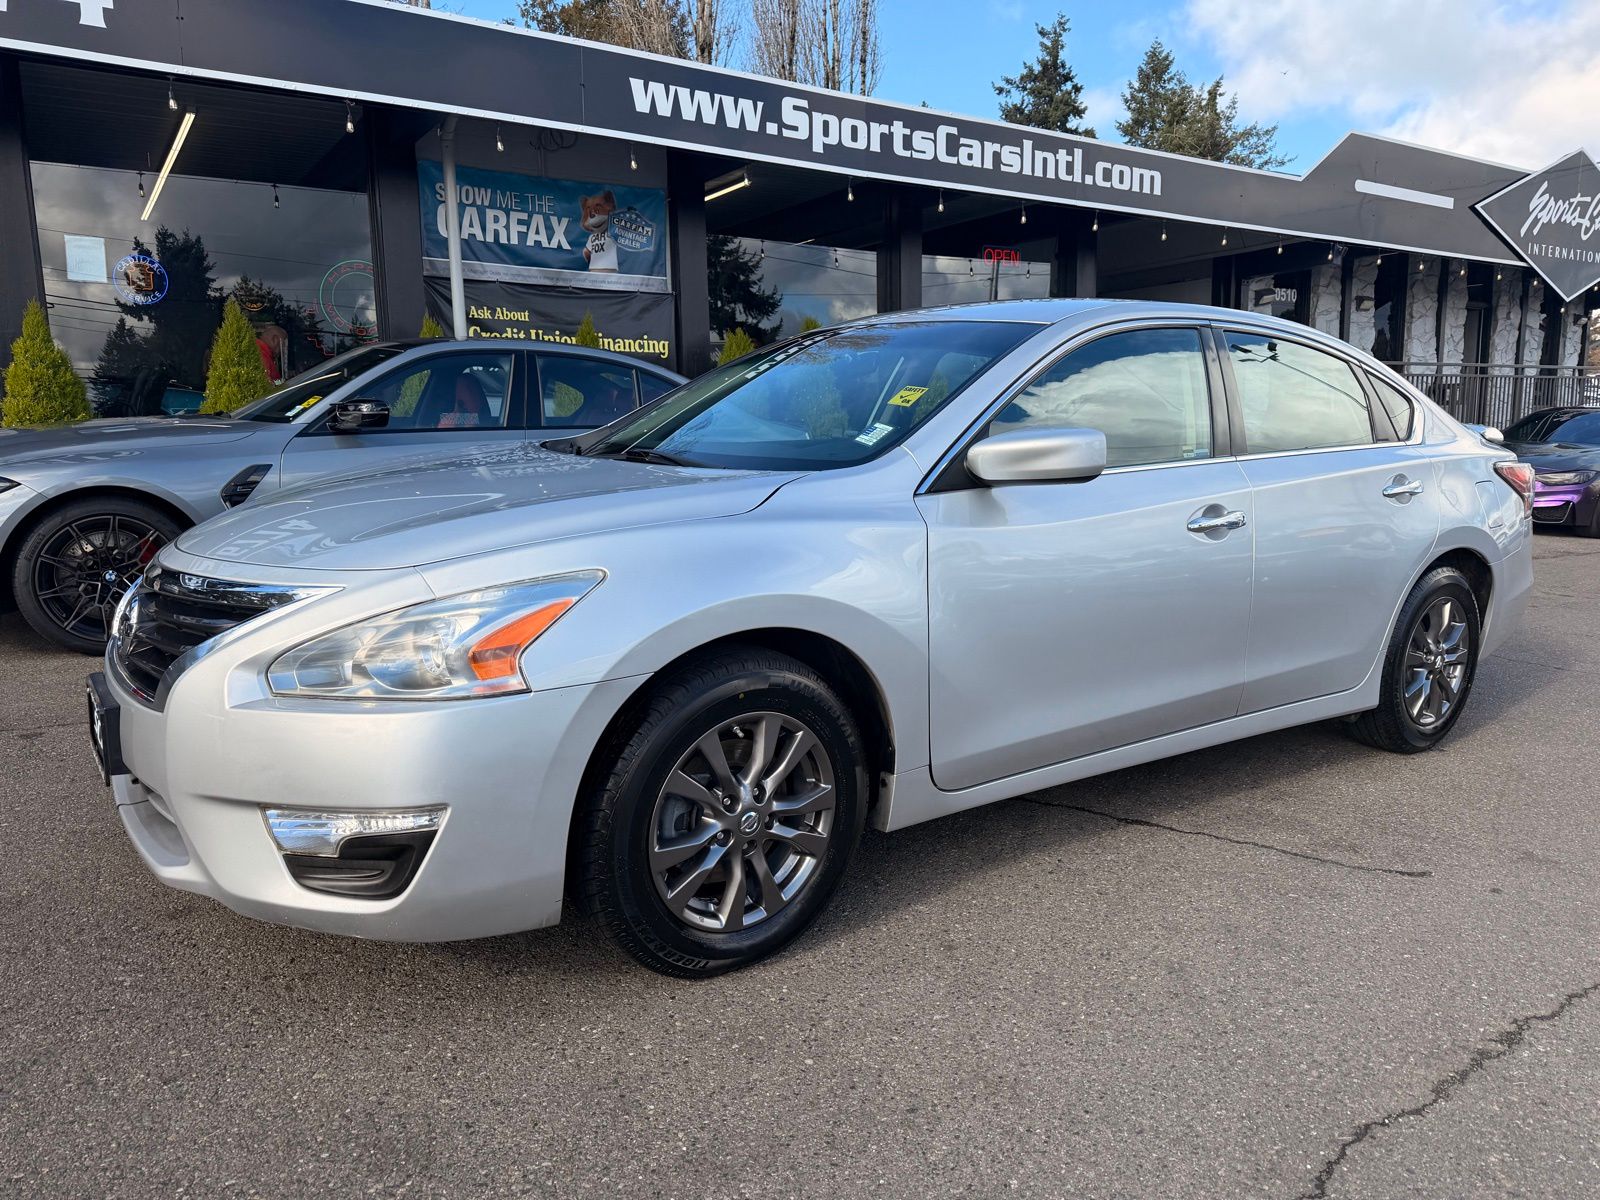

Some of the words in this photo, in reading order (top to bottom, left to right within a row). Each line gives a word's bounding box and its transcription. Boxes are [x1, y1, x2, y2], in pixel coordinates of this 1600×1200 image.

[629, 77, 1162, 196] www.SportsCarsIntl.com
[497, 190, 521, 210] ME
[524, 193, 554, 214] THE
[613, 218, 651, 236] CARFAX
[614, 227, 647, 244] ADVANTAGE
[618, 236, 640, 249] DEALER
[117, 255, 163, 276] CADILLAC
[983, 247, 1020, 267] OPEN
[122, 290, 162, 303] SERVICE
[469, 305, 493, 320] Ask
[494, 307, 530, 323] About
[595, 332, 669, 359] inancing
[903, 386, 926, 394] SAFETY
